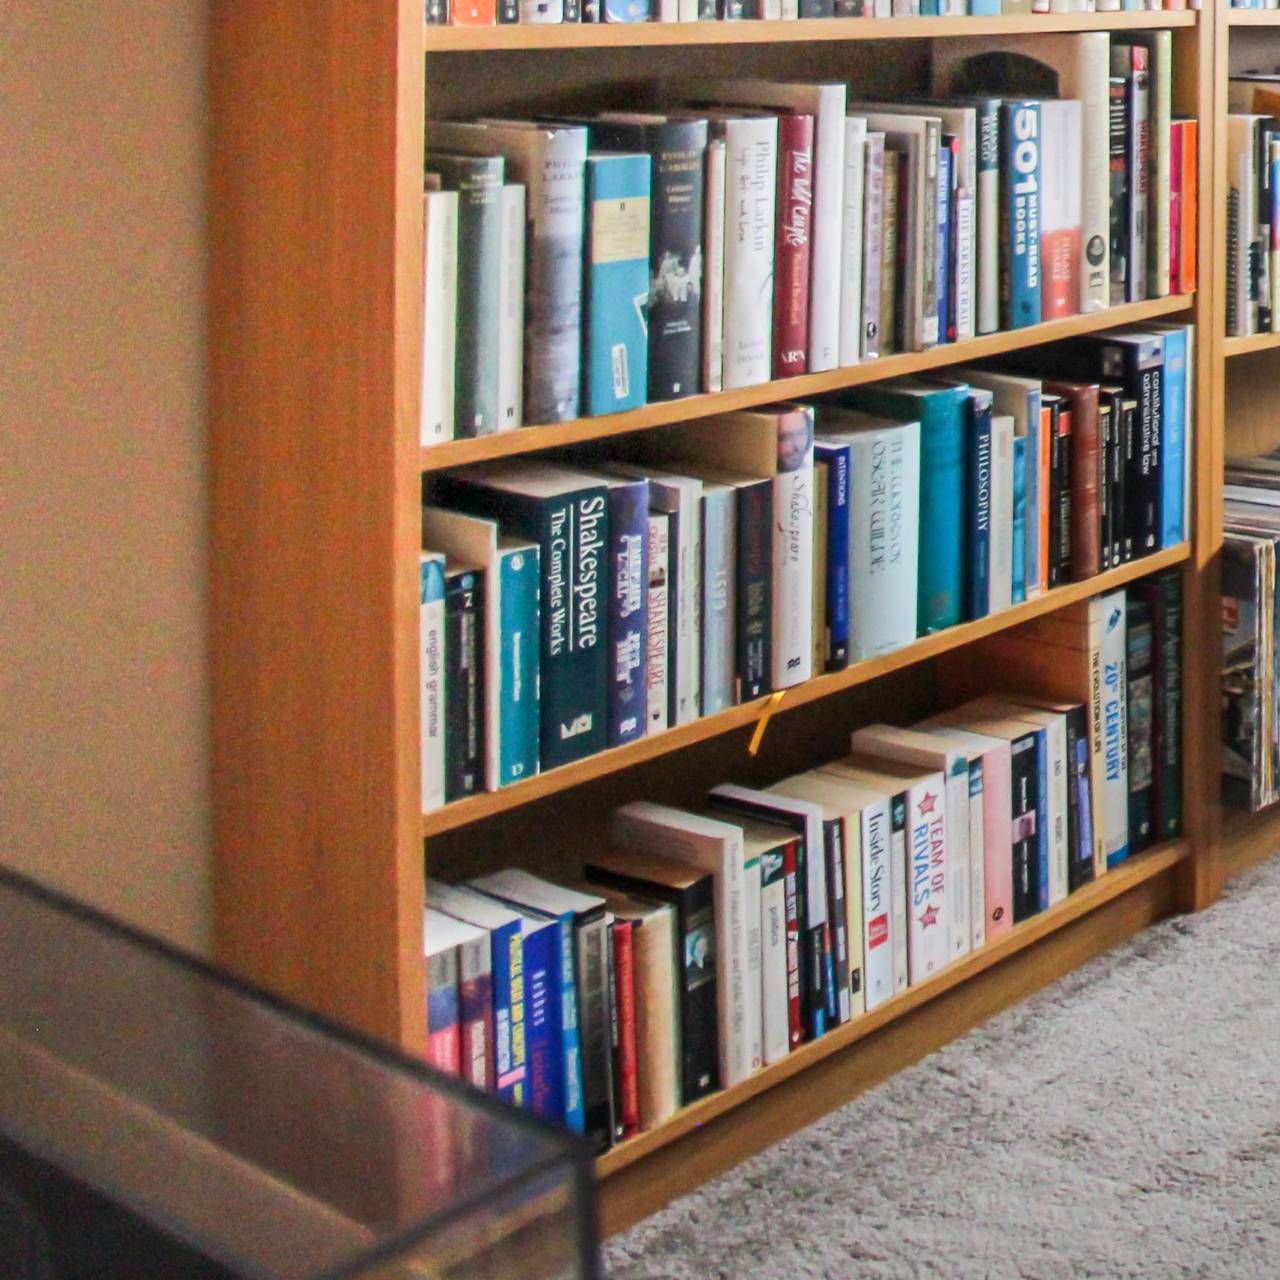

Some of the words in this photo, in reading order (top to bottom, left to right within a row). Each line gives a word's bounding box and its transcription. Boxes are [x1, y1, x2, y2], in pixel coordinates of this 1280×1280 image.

[752, 141, 769, 192] Philip
[1014, 108, 1038, 195] 501
[754, 198, 769, 252] Larkin
[961, 207, 971, 234] THE
[1016, 196, 1026, 255] BOOKS
[1028, 195, 1037, 288] MUST-READ
[961, 238, 971, 286] LARKIN
[1143, 373, 1151, 452] administrative
[1152, 371, 1161, 446] constitutional
[837, 455, 846, 506] INTENTIONS
[871, 441, 885, 504] OSCAR
[977, 434, 989, 531] PHILOSOPHY
[1143, 454, 1151, 475] law
[551, 508, 566, 536] The
[779, 474, 811, 562] Shakespeare
[548, 539, 566, 607] Complete
[574, 497, 604, 649] Shakespeare
[427, 629, 442, 675] english
[550, 608, 565, 655] Works
[649, 592, 666, 688] SHAKESPEARE
[427, 680, 438, 738] grammar
[1104, 701, 1120, 781] CENTURY
[868, 812, 884, 867] Inside
[914, 824, 929, 907] RIVALS
[930, 816, 944, 868] TEAM
[868, 868, 885, 913] Story
[931, 871, 945, 896] OF
